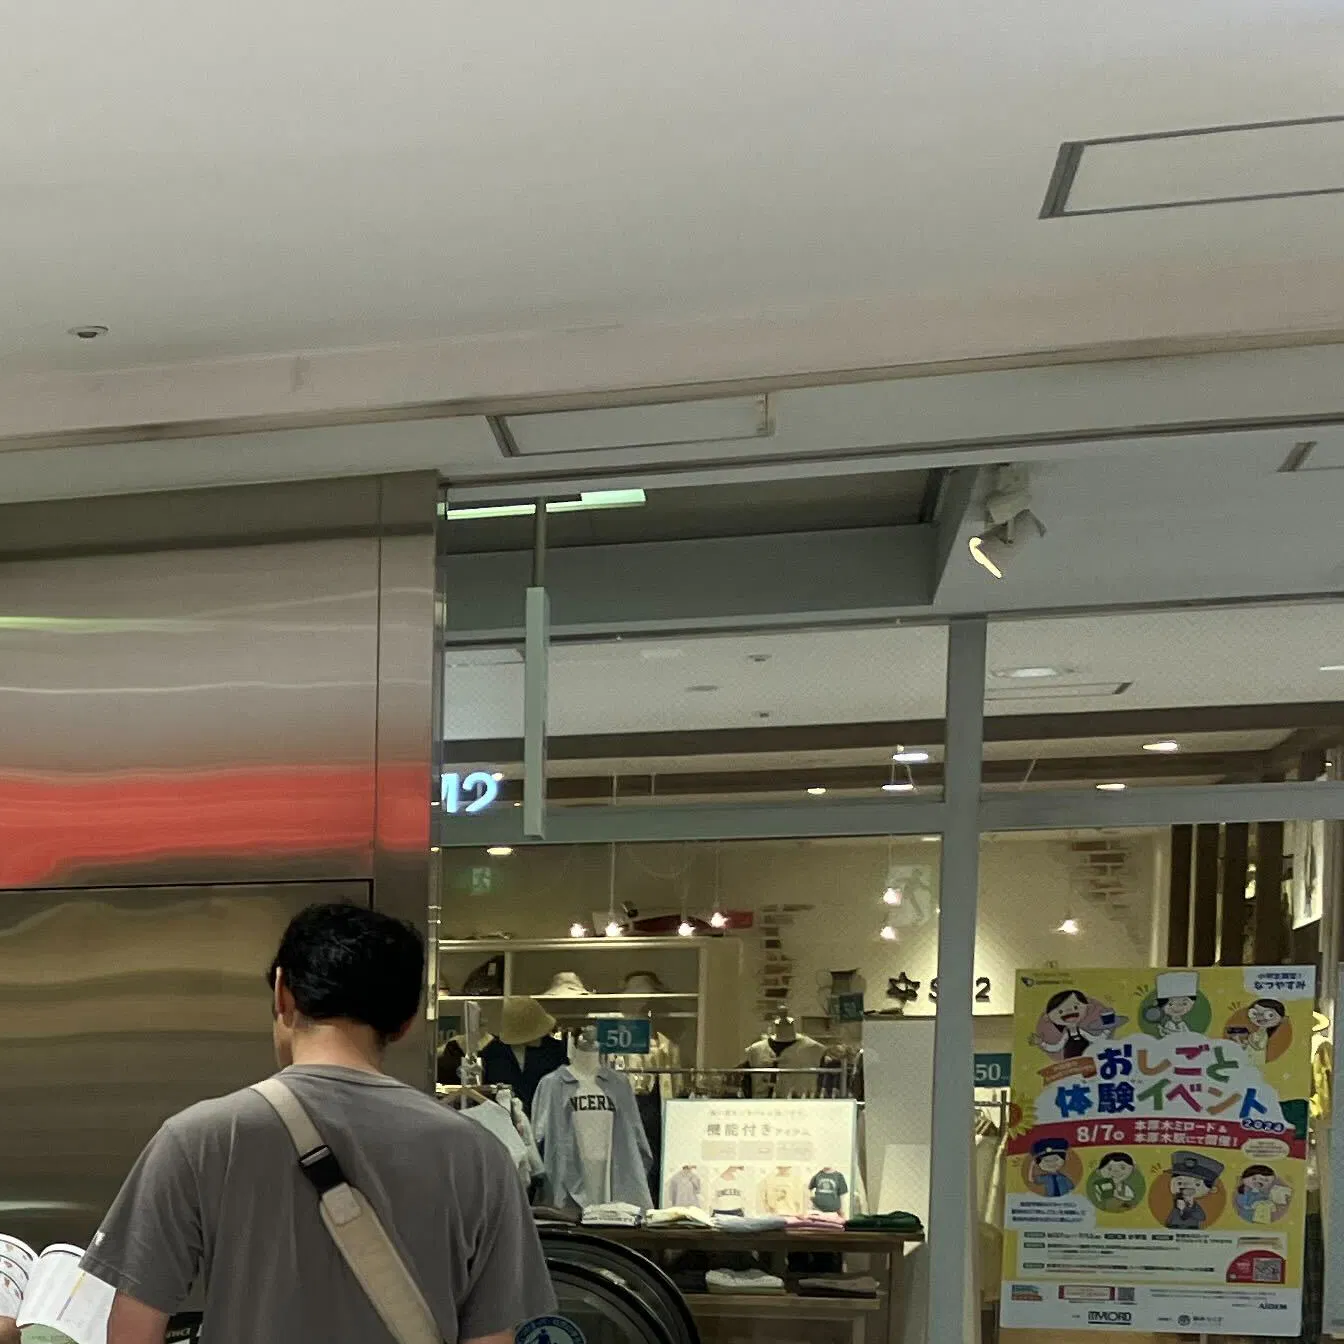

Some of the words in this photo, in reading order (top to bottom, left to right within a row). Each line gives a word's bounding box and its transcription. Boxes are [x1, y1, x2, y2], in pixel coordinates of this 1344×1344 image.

[606, 1030, 632, 1048] 50
[975, 1063, 1002, 1081] 50
[1097, 1044, 1239, 1083] おしごと
[1054, 1079, 1268, 1118] 体験イベント
